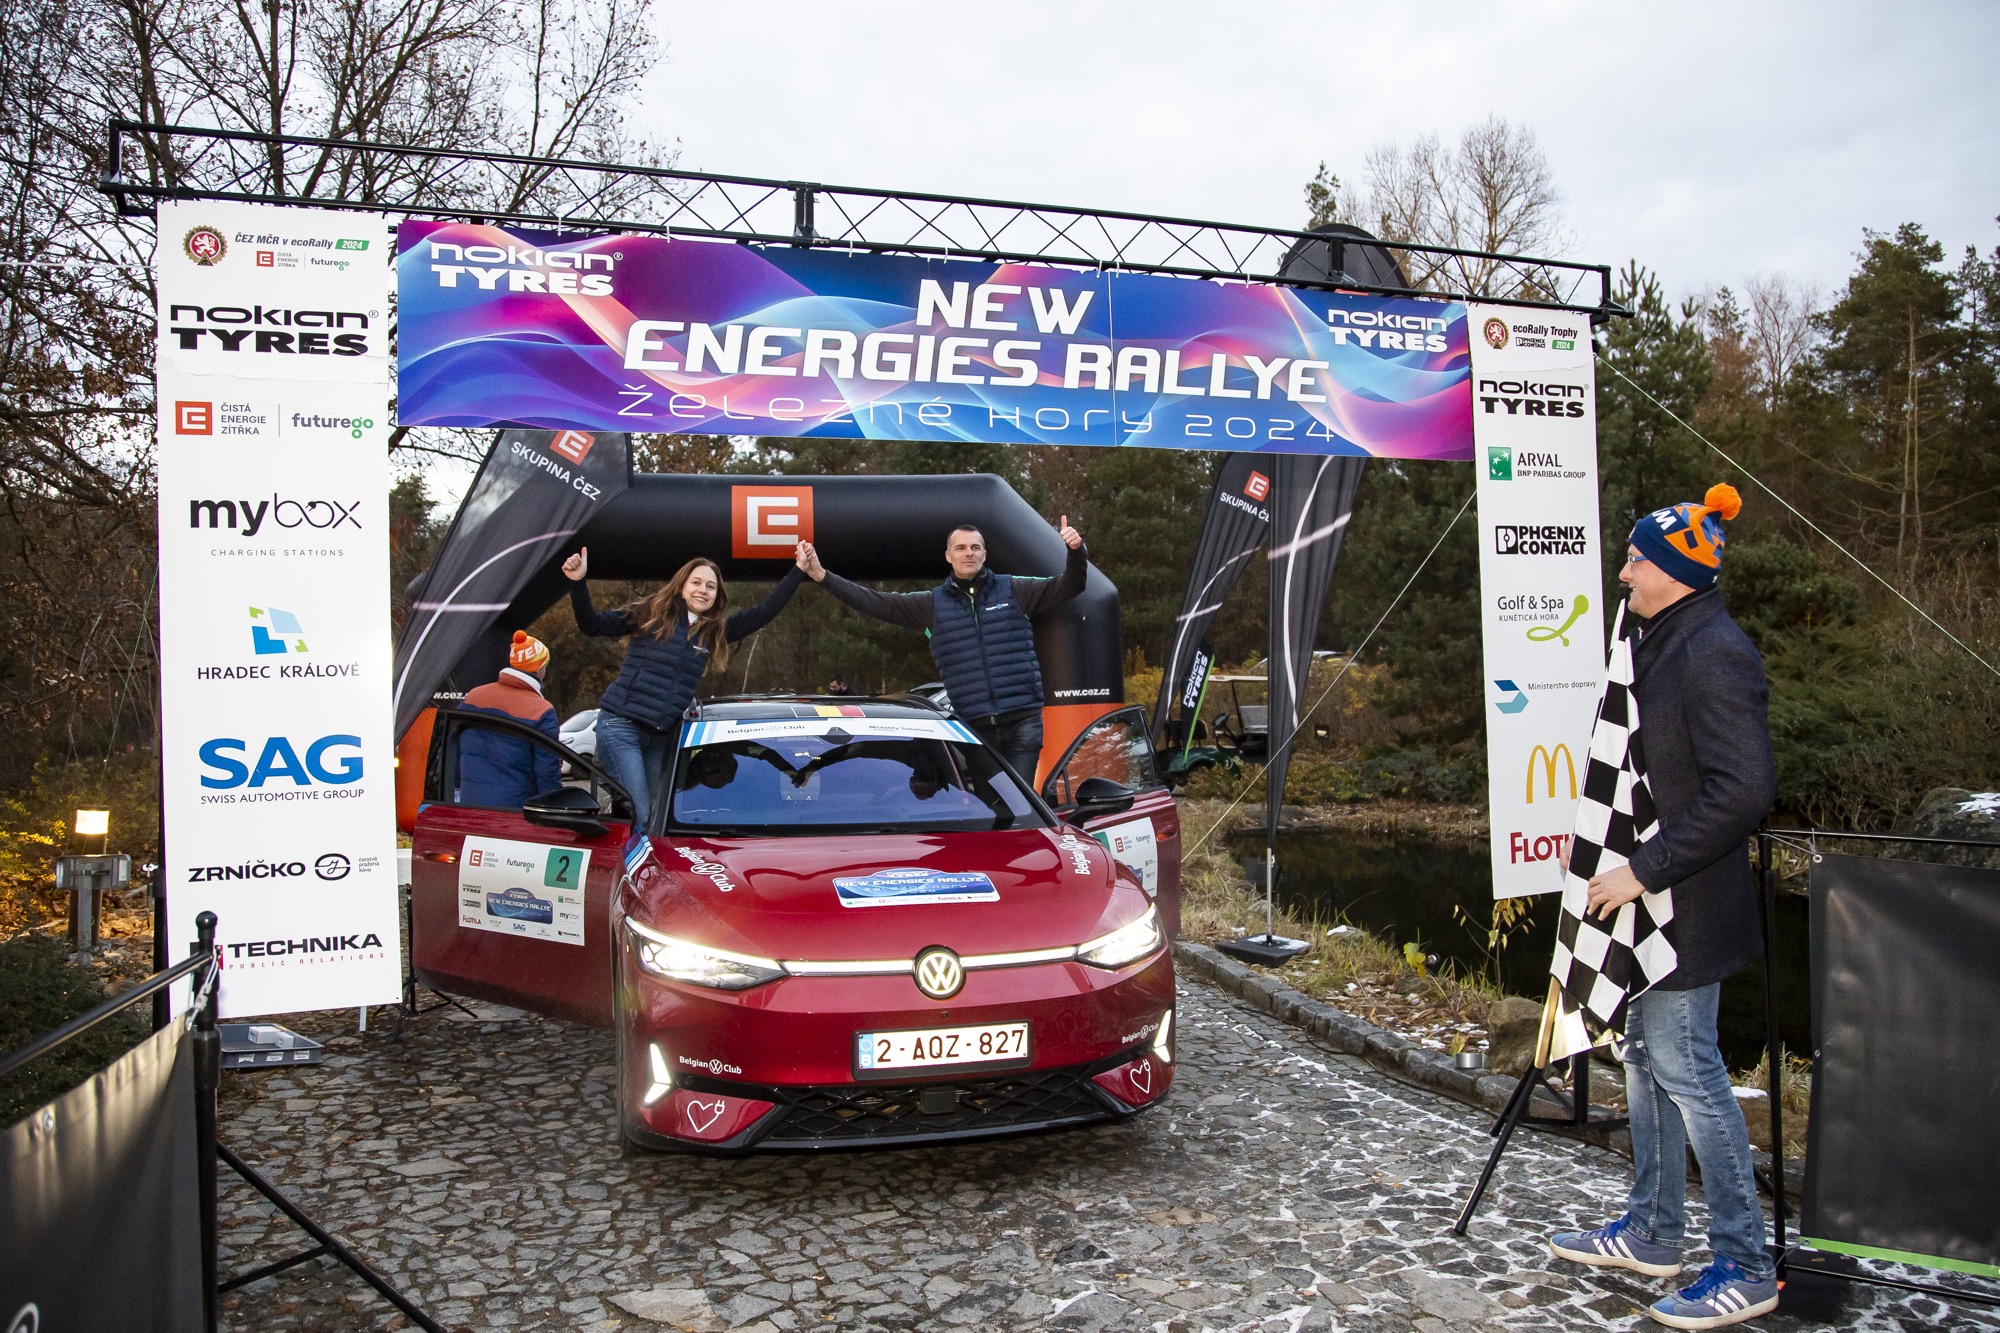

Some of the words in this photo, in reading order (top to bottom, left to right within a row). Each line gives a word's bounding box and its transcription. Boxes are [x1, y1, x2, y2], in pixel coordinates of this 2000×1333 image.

[235, 232, 254, 243] ČEZ
[256, 234, 279, 245] MČR
[291, 238, 334, 250] ecoRally
[342, 240, 363, 249] 2024
[310, 257, 350, 271] futurego
[431, 264, 614, 296] TYRES
[916, 278, 1095, 335] NEW
[1328, 326, 1448, 353] TYRES
[1512, 324, 1549, 337] ecoRally
[1550, 326, 1578, 339] Trophy
[170, 327, 369, 357] TYRES
[1556, 340, 1571, 349] 2024
[624, 319, 1042, 387] ENERGIES
[1063, 339, 1330, 403] RALLYE
[220, 402, 252, 413] ČISTÁ
[1479, 396, 1585, 418] TYRES
[220, 415, 267, 424] ENERGIE
[292, 412, 374, 439] futurego
[1185, 414, 1335, 442] 2024
[221, 425, 260, 435] ZÍTŘKA
[1517, 452, 1562, 468] ARVAL
[510, 441, 571, 484] SKUPINA
[572, 475, 602, 501] ČEZ
[1533, 470, 1562, 478] PARIBAS
[1563, 471, 1587, 479] GROUP
[1220, 492, 1258, 517] SKUPINA
[211, 549, 277, 557] CHARGING
[283, 549, 344, 557] STATIONS
[1519, 540, 1586, 555] CONTACT
[1497, 595, 1525, 610] Golf
[1528, 597, 1538, 610] &
[1541, 595, 1564, 613] Spa
[197, 665, 271, 680] HRADEC
[280, 661, 360, 678] KRÁLOVÉ
[1187, 654, 1208, 708] TYRES
[1527, 681, 1569, 691] Ministerstvo
[1570, 680, 1597, 691] dopravy
[1054, 688, 1110, 698] www.cez.cz
[198, 734, 364, 790] SAG
[200, 794, 236, 805] SWISS
[239, 791, 319, 803] AUTOMOTIVE
[323, 789, 364, 800] GROUP
[1510, 832, 1574, 864] FLOT
[188, 859, 306, 883] ZRNÍČKO
[506, 858, 535, 873] futurego
[555, 855, 570, 883] 2
[709, 874, 736, 892] Club
[513, 923, 526, 931] SAG
[228, 933, 383, 958] TECHNIKA
[229, 960, 286, 970] PUBLIC
[299, 952, 385, 965] RELATIONS
[1121, 1032, 1140, 1044] Belgian
[1148, 1022, 1159, 1032] Club
[679, 1055, 708, 1068] Belgian
[723, 1064, 742, 1075] Club
[860, 1054, 872, 1066] B
